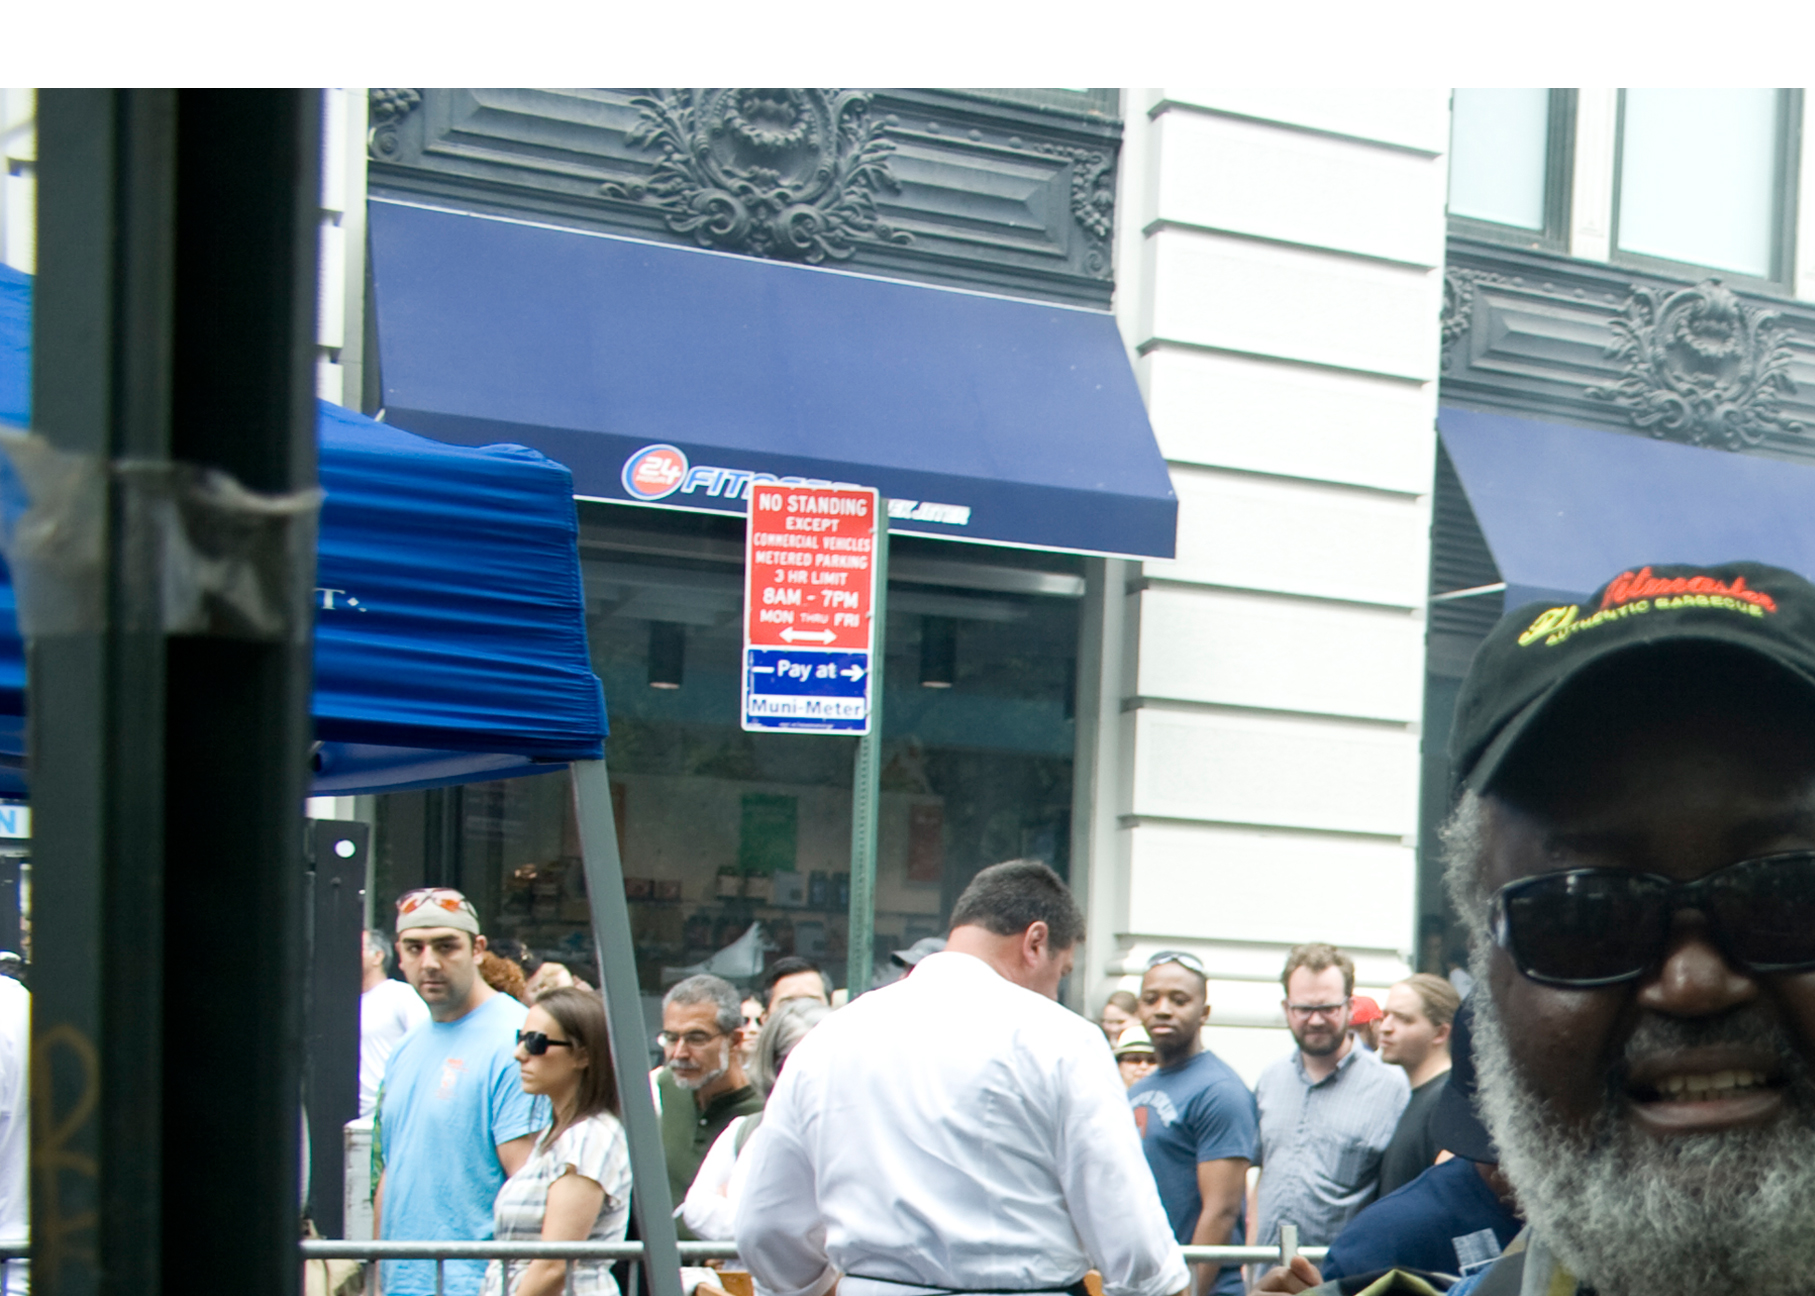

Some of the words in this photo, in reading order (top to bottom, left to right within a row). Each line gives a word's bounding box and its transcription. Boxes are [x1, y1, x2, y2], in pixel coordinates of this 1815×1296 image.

[638, 456, 682, 485] 24
[759, 493, 783, 511] NO
[787, 495, 868, 516] STANDING
[785, 516, 840, 532] EXCEPT
[753, 532, 819, 549] COMMERCIAL
[822, 536, 871, 552] VEHICLES
[755, 550, 813, 567] METERED
[814, 553, 868, 570] PARKING
[774, 568, 785, 583] 3
[787, 569, 808, 585] HR
[810, 570, 848, 586] LIMIT
[762, 586, 802, 607] 8AM
[820, 589, 859, 609] 7PM
[760, 608, 795, 624] MON
[799, 612, 829, 625] THRU
[833, 612, 860, 627] FRI
[777, 659, 813, 682] Pay
[815, 662, 837, 679] at
[752, 699, 861, 716] Muni-Meter
